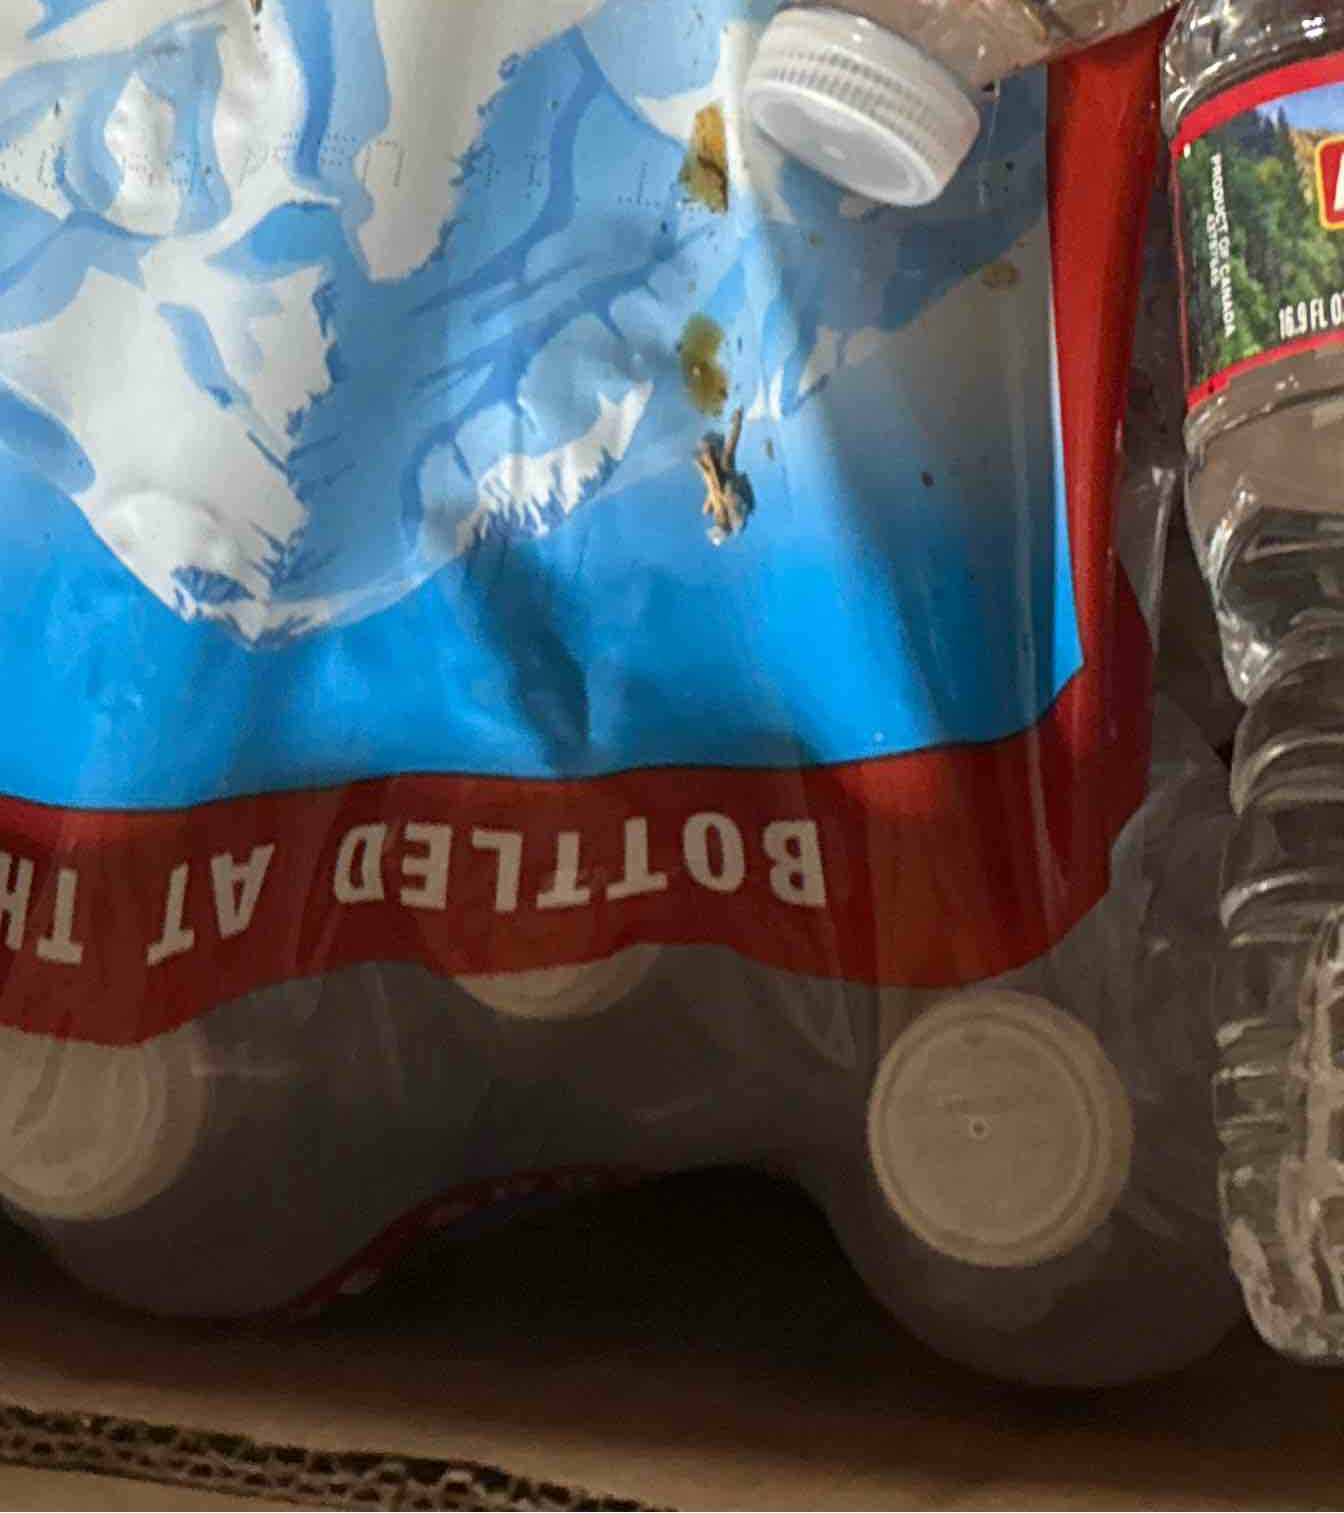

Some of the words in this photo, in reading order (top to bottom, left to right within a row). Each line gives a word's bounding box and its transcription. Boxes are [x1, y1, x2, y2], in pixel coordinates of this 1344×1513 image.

[1209, 151, 1229, 233] PRODUCT
[1278, 305, 1309, 340] 16.9
[1309, 300, 1329, 332] FL
[145, 843, 277, 967] AT
[332, 810, 828, 914] BOTTLED
